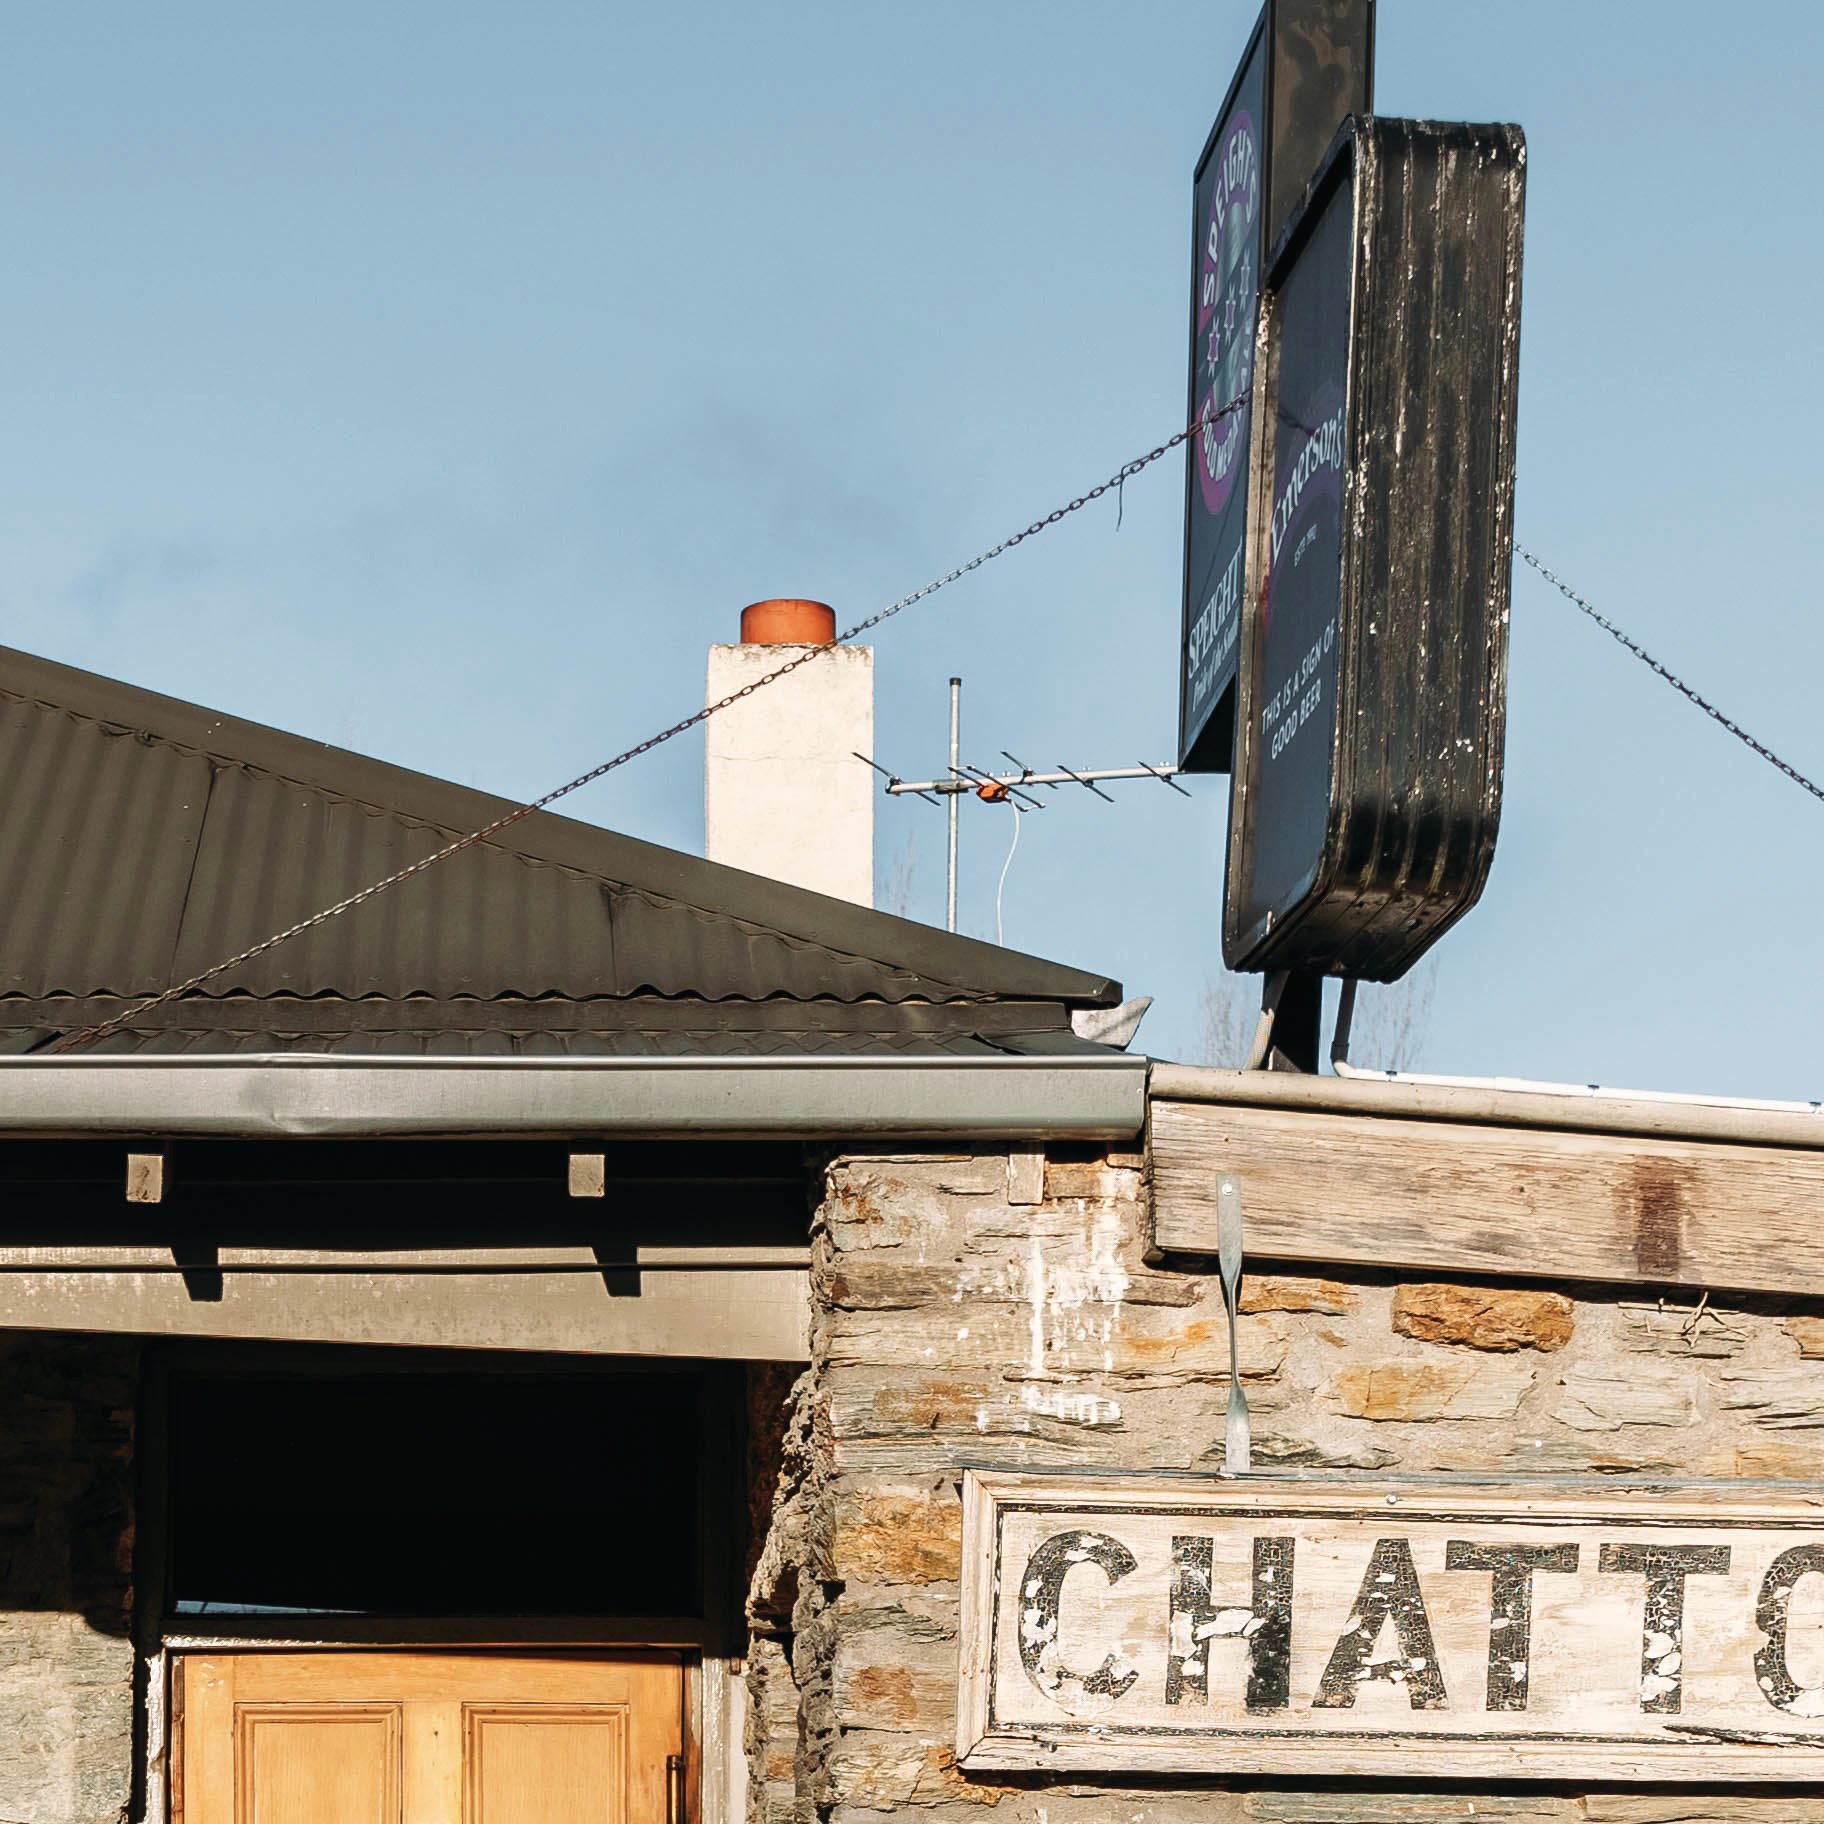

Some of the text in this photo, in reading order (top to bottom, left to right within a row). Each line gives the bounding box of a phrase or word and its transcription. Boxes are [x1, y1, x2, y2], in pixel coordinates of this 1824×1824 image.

[1271, 408, 1342, 568] Emerson's
[1262, 617, 1336, 736] THIS IS A SIGN OF
[1271, 677, 1322, 761] GOOD BEER
